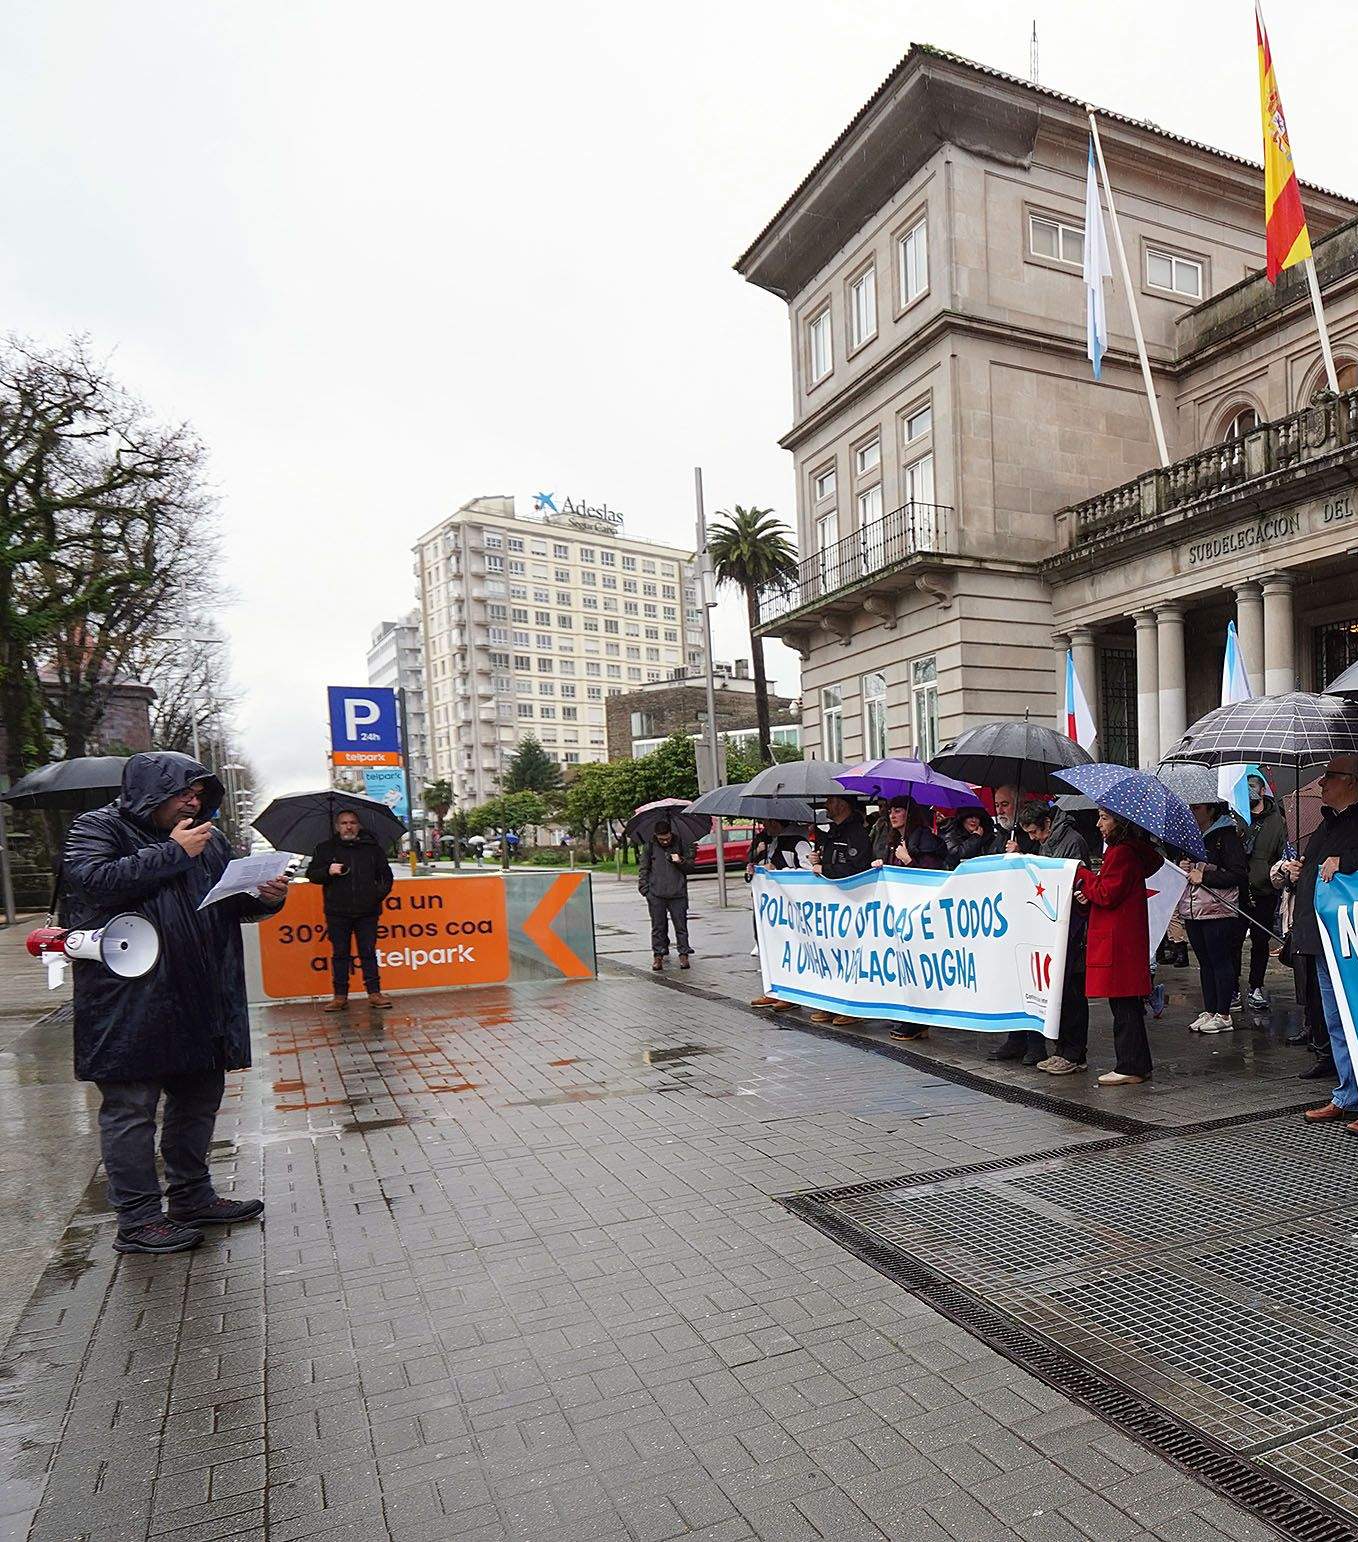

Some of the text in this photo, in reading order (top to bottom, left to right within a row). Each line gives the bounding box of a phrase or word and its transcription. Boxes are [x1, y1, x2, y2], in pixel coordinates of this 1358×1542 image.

[562, 496, 624, 523] Adeslas
[1187, 512, 1301, 564] SUBDELEGACION
[1322, 497, 1353, 524] DEL
[344, 698, 381, 741] P
[360, 732, 381, 741] 24h
[345, 753, 386, 763] telpark
[410, 894, 443, 910] un
[921, 901, 935, 940] E
[939, 892, 1008, 939] TODOS
[278, 919, 493, 944] 30% enos coa
[376, 944, 475, 970] telpark
[782, 941, 792, 972] A
[919, 947, 977, 993] DIGNA
